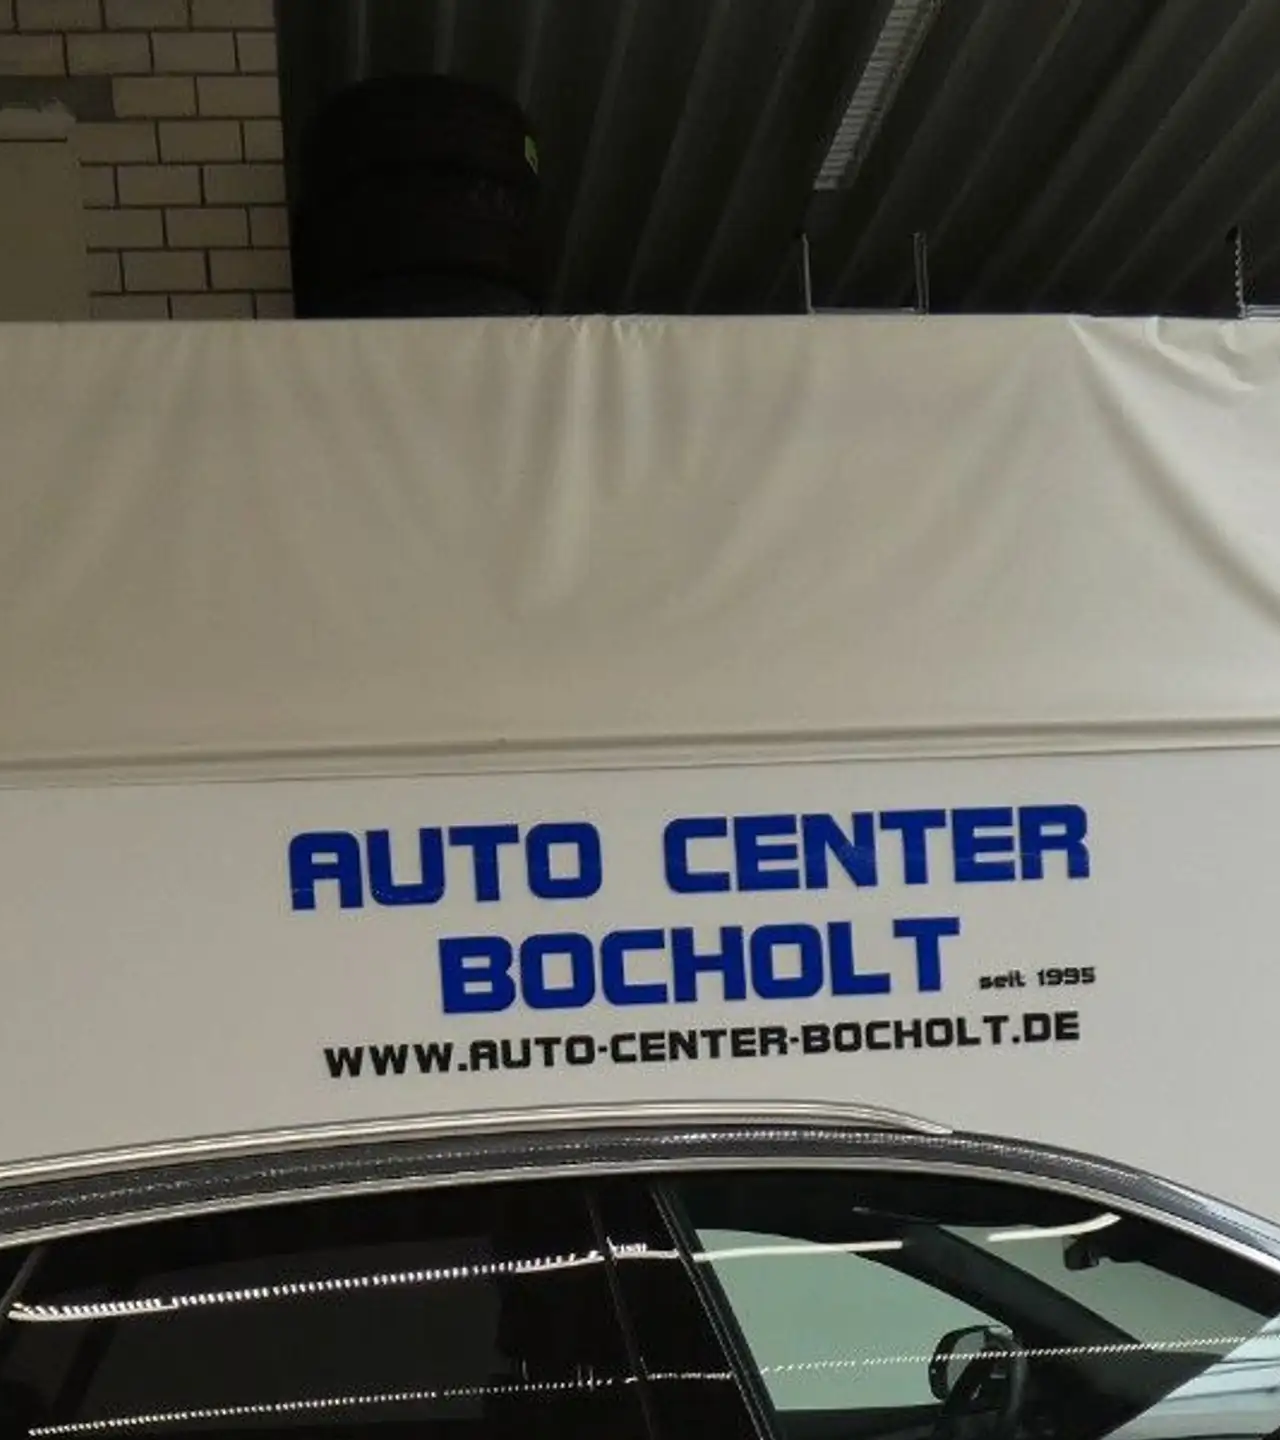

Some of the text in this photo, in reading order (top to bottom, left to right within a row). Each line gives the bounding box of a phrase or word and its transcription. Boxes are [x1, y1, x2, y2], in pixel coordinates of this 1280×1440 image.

[288, 804, 1090, 911] AUTO CENTER
[438, 916, 1096, 1015] BOCHOLT seit 1995
[323, 1011, 1080, 1079] WWW.AUTO-CENTER-BOCHOLT.DE
